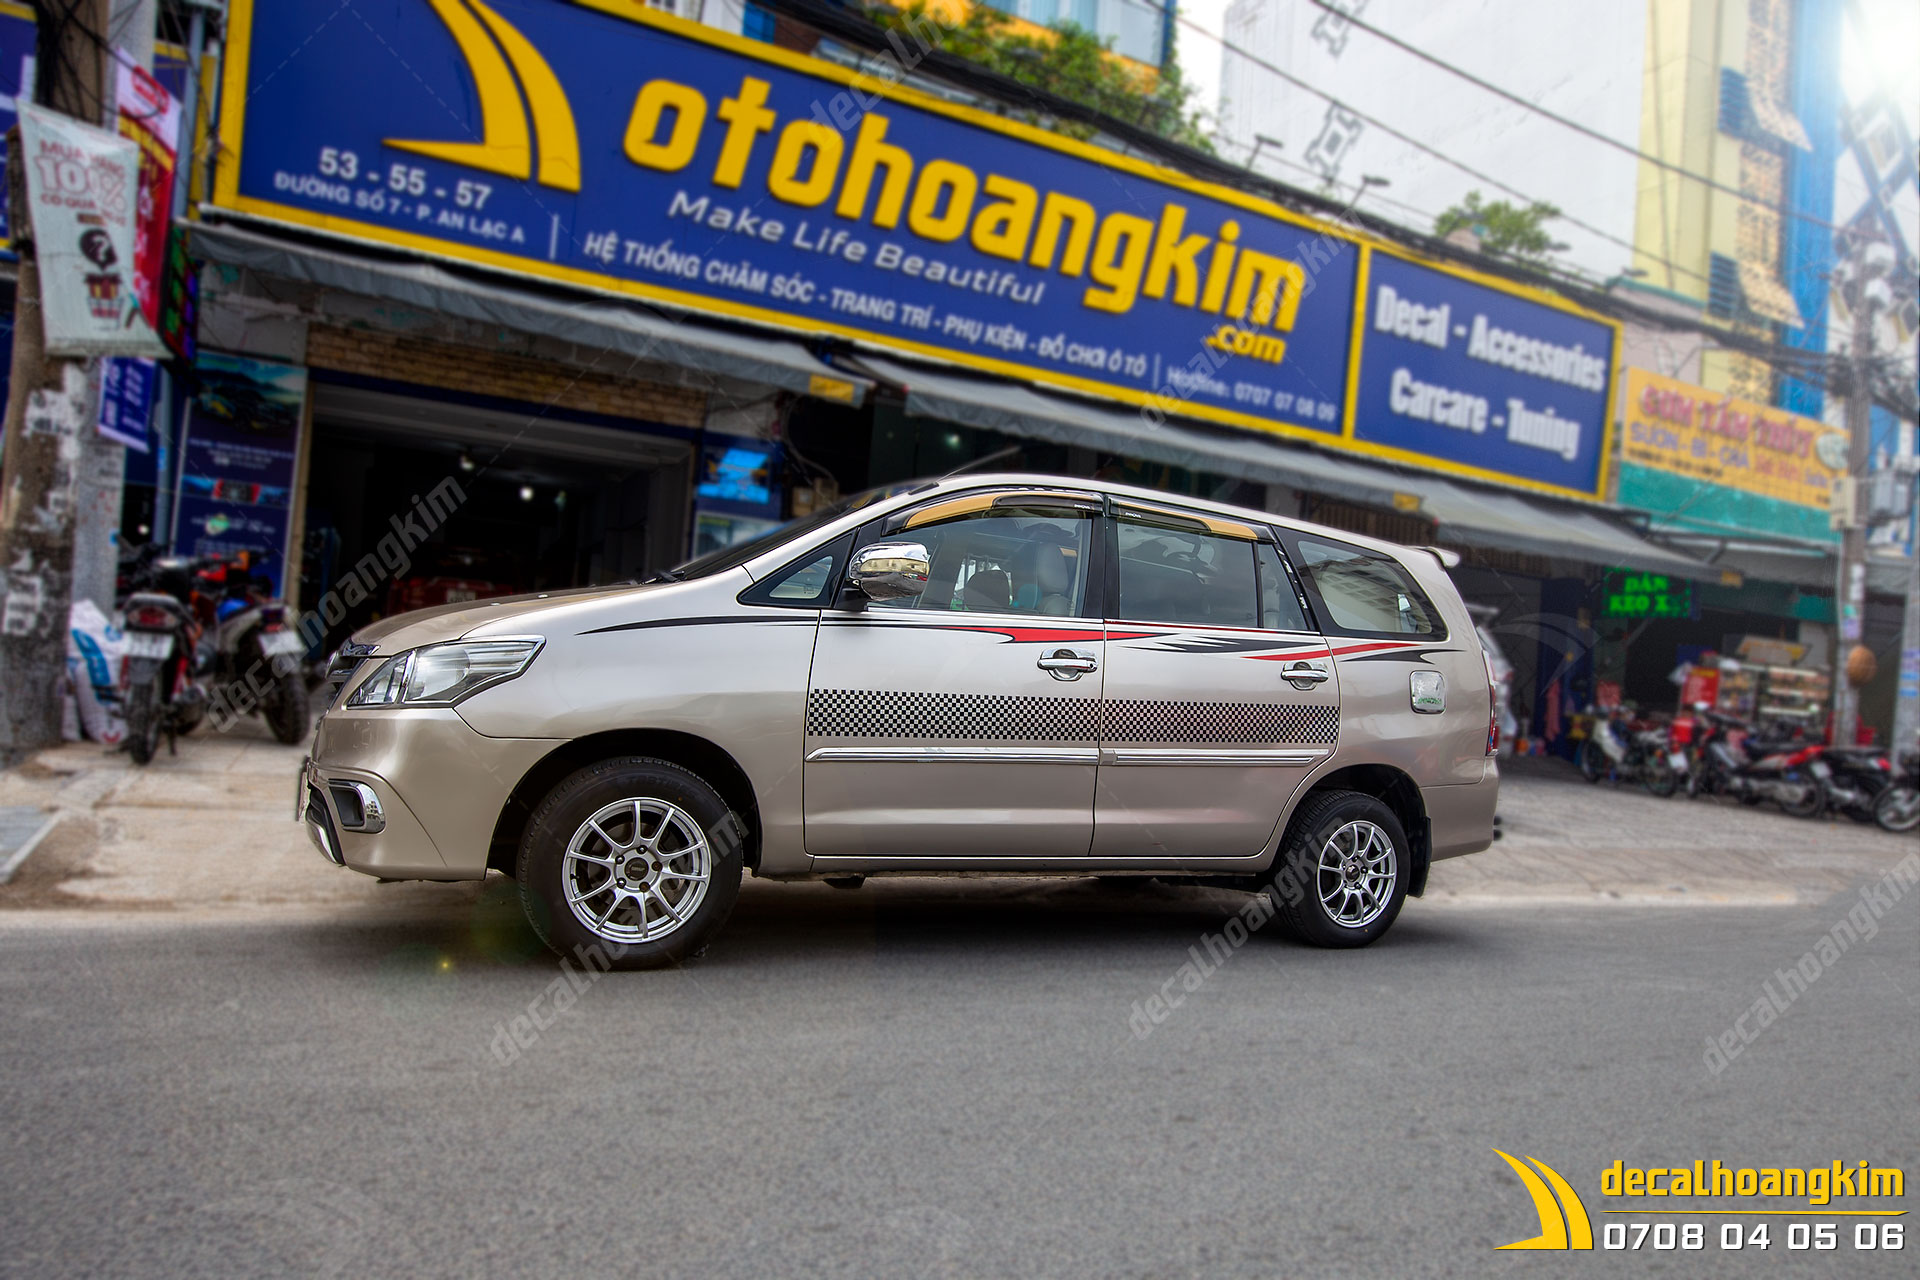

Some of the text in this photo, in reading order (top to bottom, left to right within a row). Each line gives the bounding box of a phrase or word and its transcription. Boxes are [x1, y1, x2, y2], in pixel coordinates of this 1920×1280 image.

[318, 147, 358, 180] 53
[389, 163, 427, 196] 55
[455, 179, 492, 210] 57
[437, 209, 465, 231] AN
[510, 226, 526, 244] A
[623, 76, 1306, 332] otohoangkim
[668, 190, 1046, 305] Make Life Beautiful
[584, 230, 619, 264] HỆ
[623, 239, 700, 280] THỐNG
[704, 260, 769, 293] CHĂM
[770, 271, 815, 303] SÓC
[831, 287, 896, 322] TRANG
[901, 304, 934, 331] TRÍ
[943, 314, 983, 345] PHỤ
[984, 321, 1028, 352] KIỆN
[1234, 382, 1271, 407] 0707
[1205, 324, 1287, 365] .com
[1374, 284, 1450, 349] Decal
[1467, 314, 1606, 392] Accessories
[1390, 367, 1488, 434] Carcare
[1507, 398, 1581, 461] Tuning
